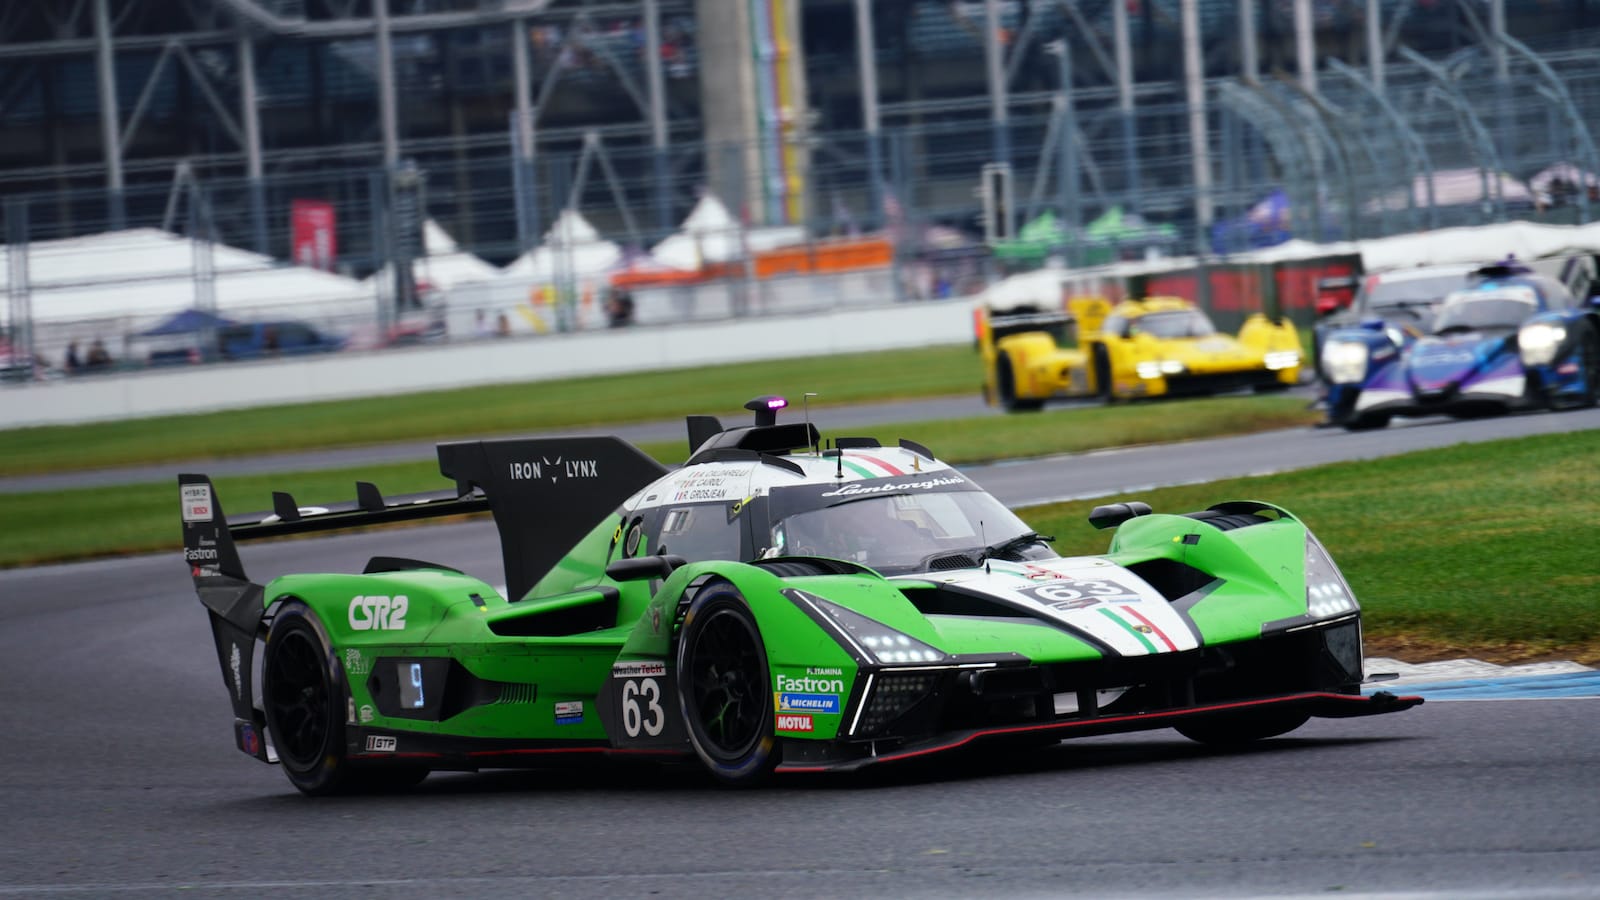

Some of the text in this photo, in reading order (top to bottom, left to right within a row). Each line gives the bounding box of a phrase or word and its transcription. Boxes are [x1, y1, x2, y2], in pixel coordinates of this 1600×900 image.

[510, 460, 598, 480] IRON LYNX
[689, 488, 727, 500] GROSJEAN
[822, 475, 966, 497] Lamborghini
[183, 547, 217, 560] Fastron
[1034, 579, 1124, 602] 63
[348, 595, 409, 630] CSR2
[613, 664, 663, 675] WeatherTech
[411, 664, 425, 707] 9
[776, 675, 844, 692] Fastron
[622, 678, 665, 737] 63
[790, 699, 834, 709] MICHELIN
[777, 716, 812, 730] MOTUL
[376, 739, 395, 749] GTP
